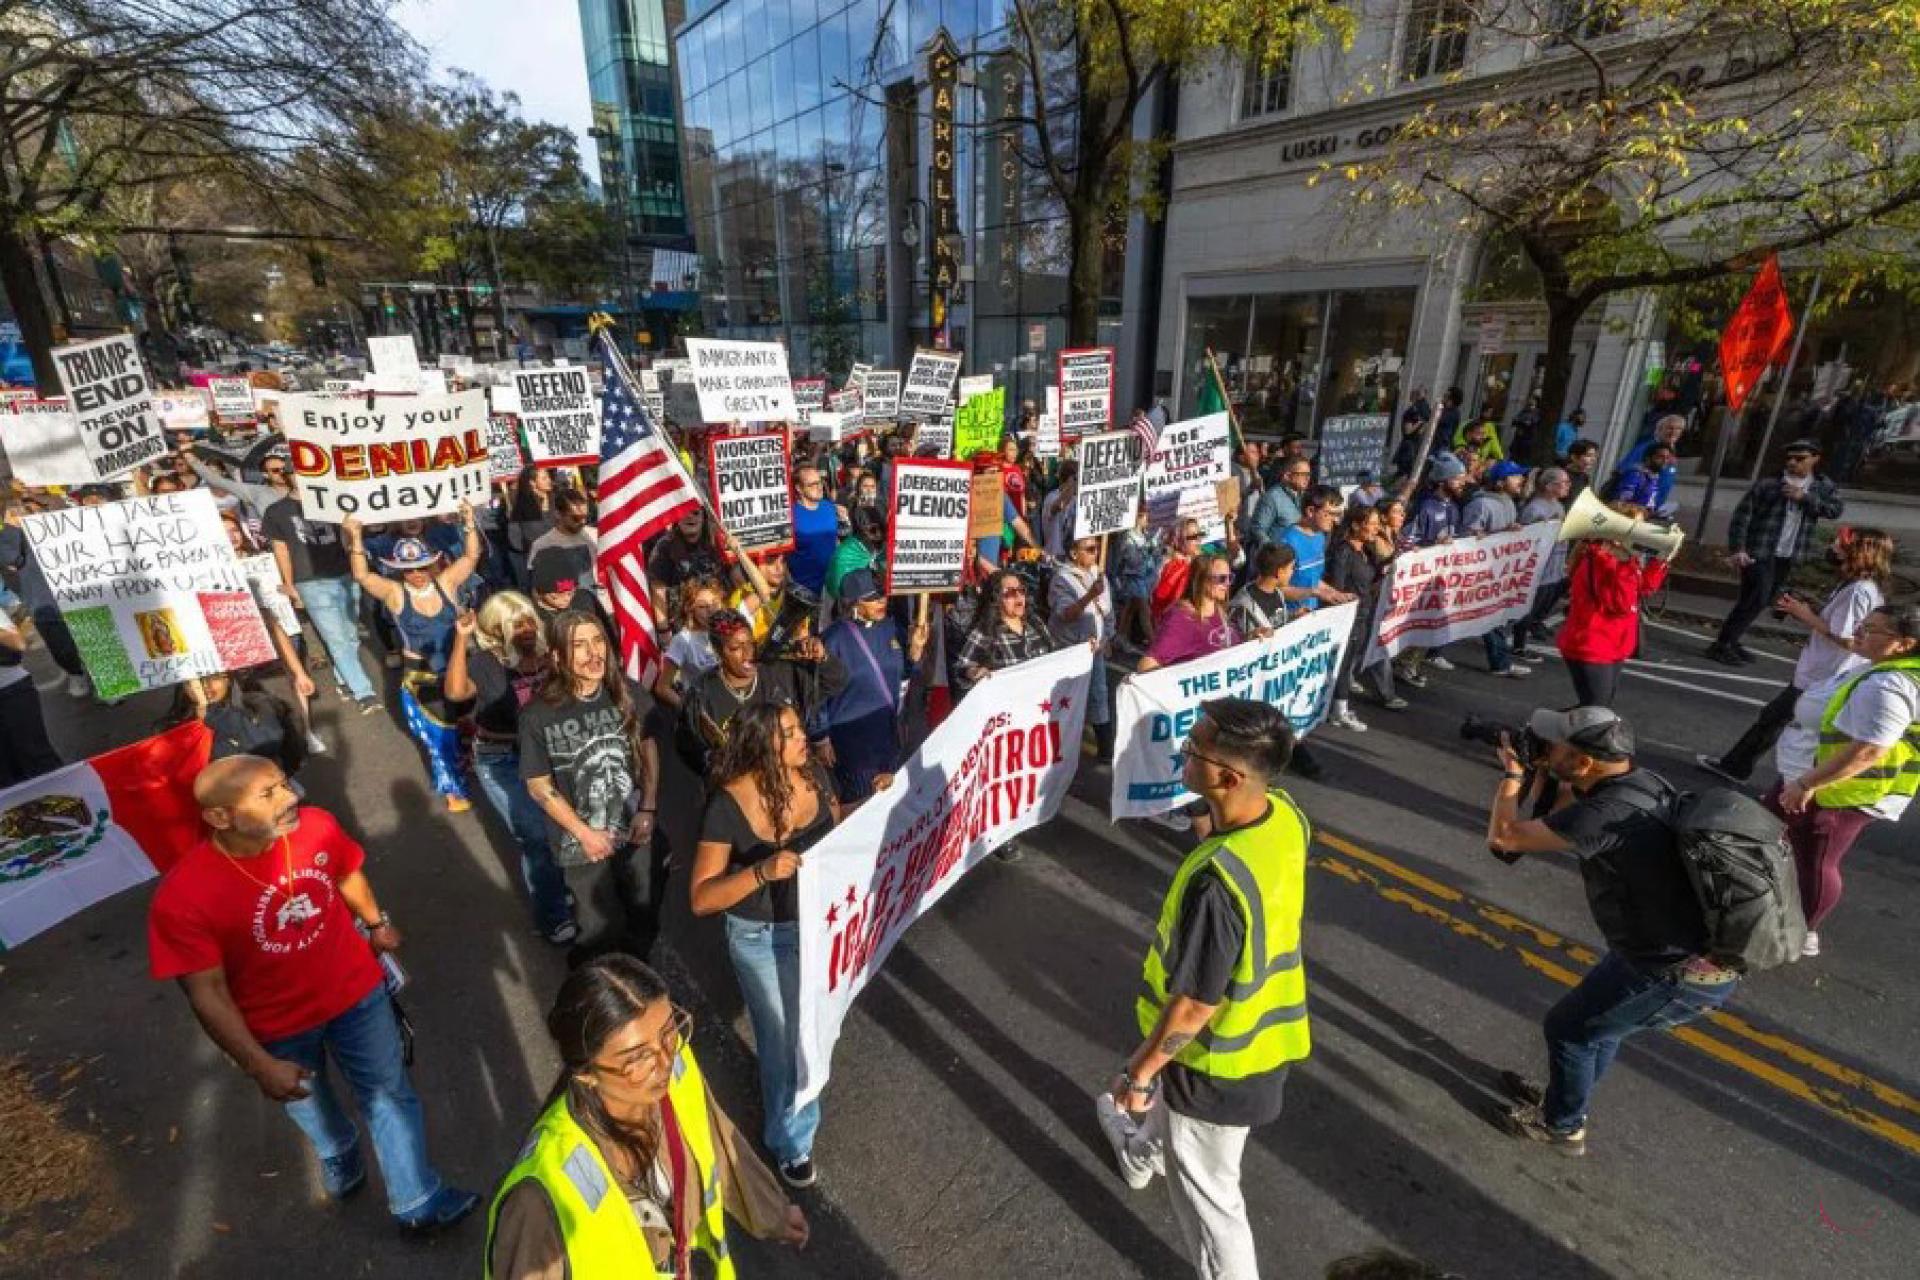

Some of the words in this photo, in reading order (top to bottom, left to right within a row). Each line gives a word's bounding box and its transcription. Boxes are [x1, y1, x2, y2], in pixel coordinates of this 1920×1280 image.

[1281, 134, 1339, 163] LUSKI
[934, 53, 953, 286] CAROLINA
[57, 341, 137, 388] TRUMP:
[697, 349, 777, 368] IMMIGRANTS
[72, 374, 143, 412] END
[516, 371, 585, 398] DEFEND
[698, 376, 732, 391] MAKE
[81, 412, 116, 431] THE
[114, 401, 151, 420] WAR
[724, 395, 768, 413] GREAT
[98, 415, 149, 450] ON
[303, 410, 386, 435] Enjoy
[403, 405, 463, 430] your
[715, 438, 785, 458] WORKERS
[1170, 428, 1198, 445] ICE
[288, 429, 489, 481] DENIAL
[1083, 436, 1142, 469] DEFEND
[718, 467, 786, 493] POWER
[1147, 466, 1210, 489] MALCOLM
[1215, 462, 1224, 473] X
[306, 470, 484, 514] Today!!!
[721, 496, 756, 519] NOT
[758, 493, 789, 513] THE
[119, 496, 186, 521] TAKE
[897, 494, 968, 520] PLENOS
[38, 540, 95, 570] OUR
[104, 519, 198, 556] HARD
[1411, 562, 1432, 577] EL
[1491, 540, 1531, 559] UNIDO
[45, 558, 152, 588] WORKING
[112, 577, 168, 599] FROM
[1178, 670, 1221, 698] THE
[543, 718, 580, 739] NO
